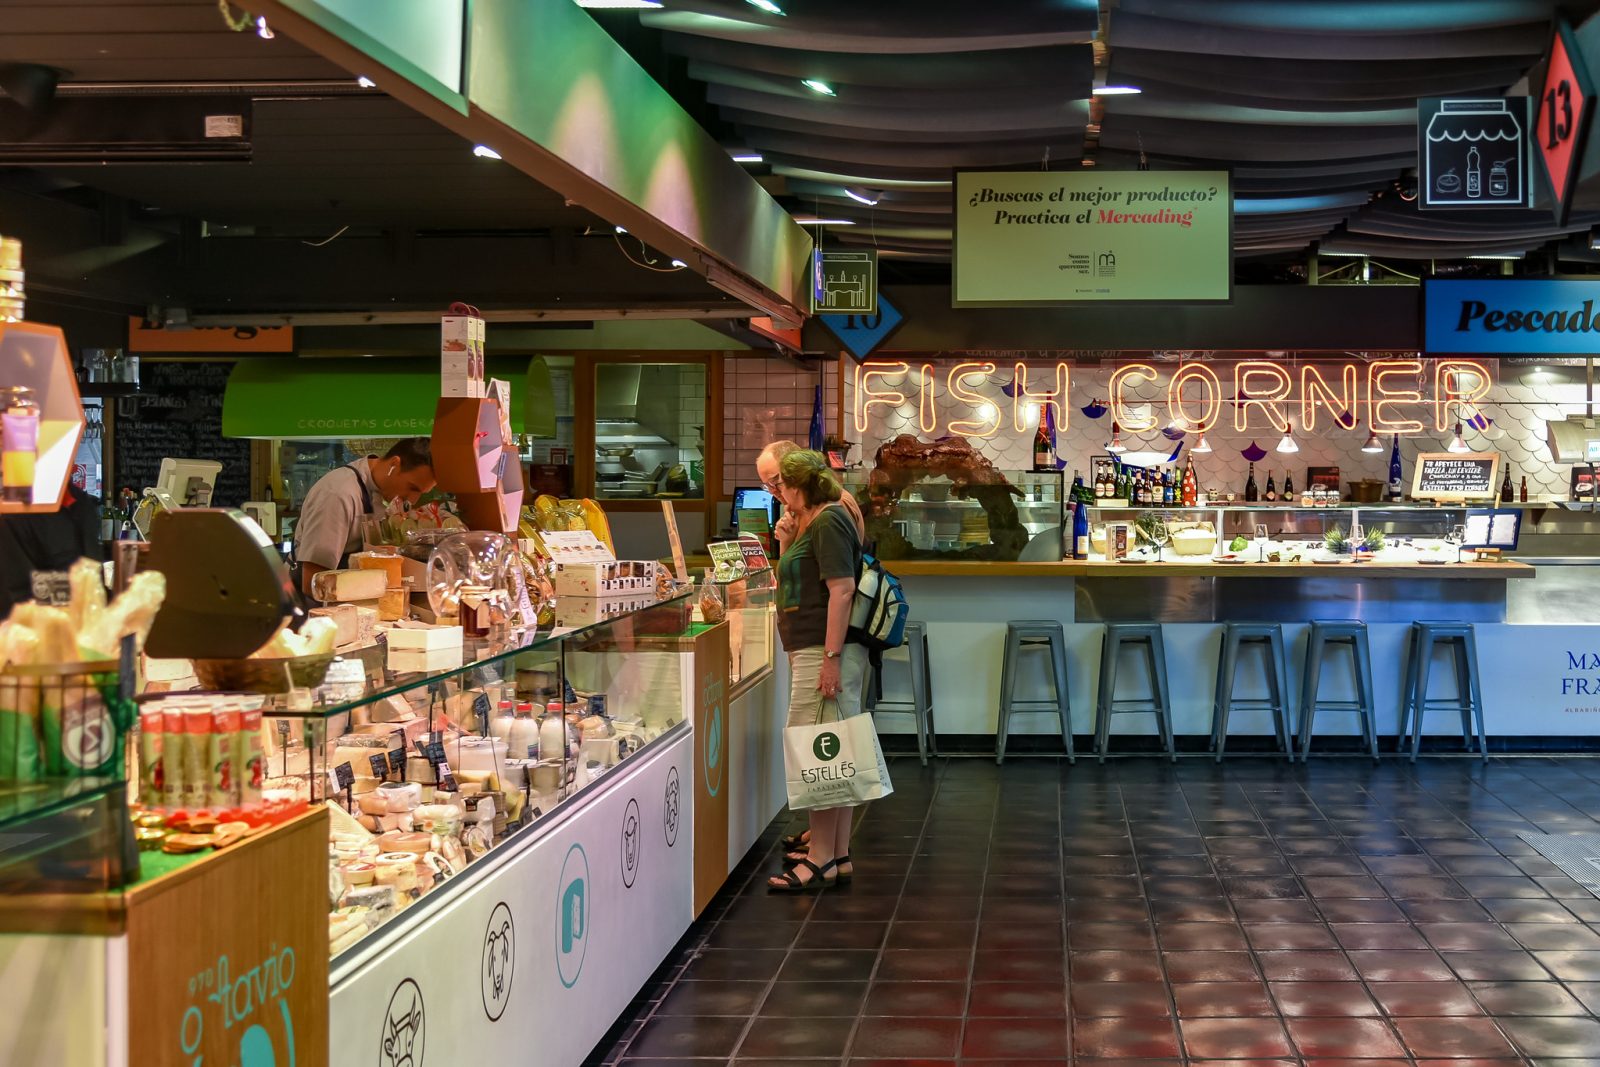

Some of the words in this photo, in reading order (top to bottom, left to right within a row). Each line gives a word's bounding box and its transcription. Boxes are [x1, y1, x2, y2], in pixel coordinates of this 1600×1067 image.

[1544, 80, 1573, 150] 13
[969, 188, 1044, 207] ¿Buscas
[1048, 187, 1064, 202] el
[1069, 187, 1122, 206] mejor
[1126, 187, 1218, 206] producto?
[994, 209, 1070, 225] Practica
[1076, 209, 1091, 224] el
[1096, 208, 1194, 228] Mercading
[854, 362, 1069, 436] FISH
[1108, 362, 1491, 433] CORNER
[297, 419, 377, 429] CROQUETAS
